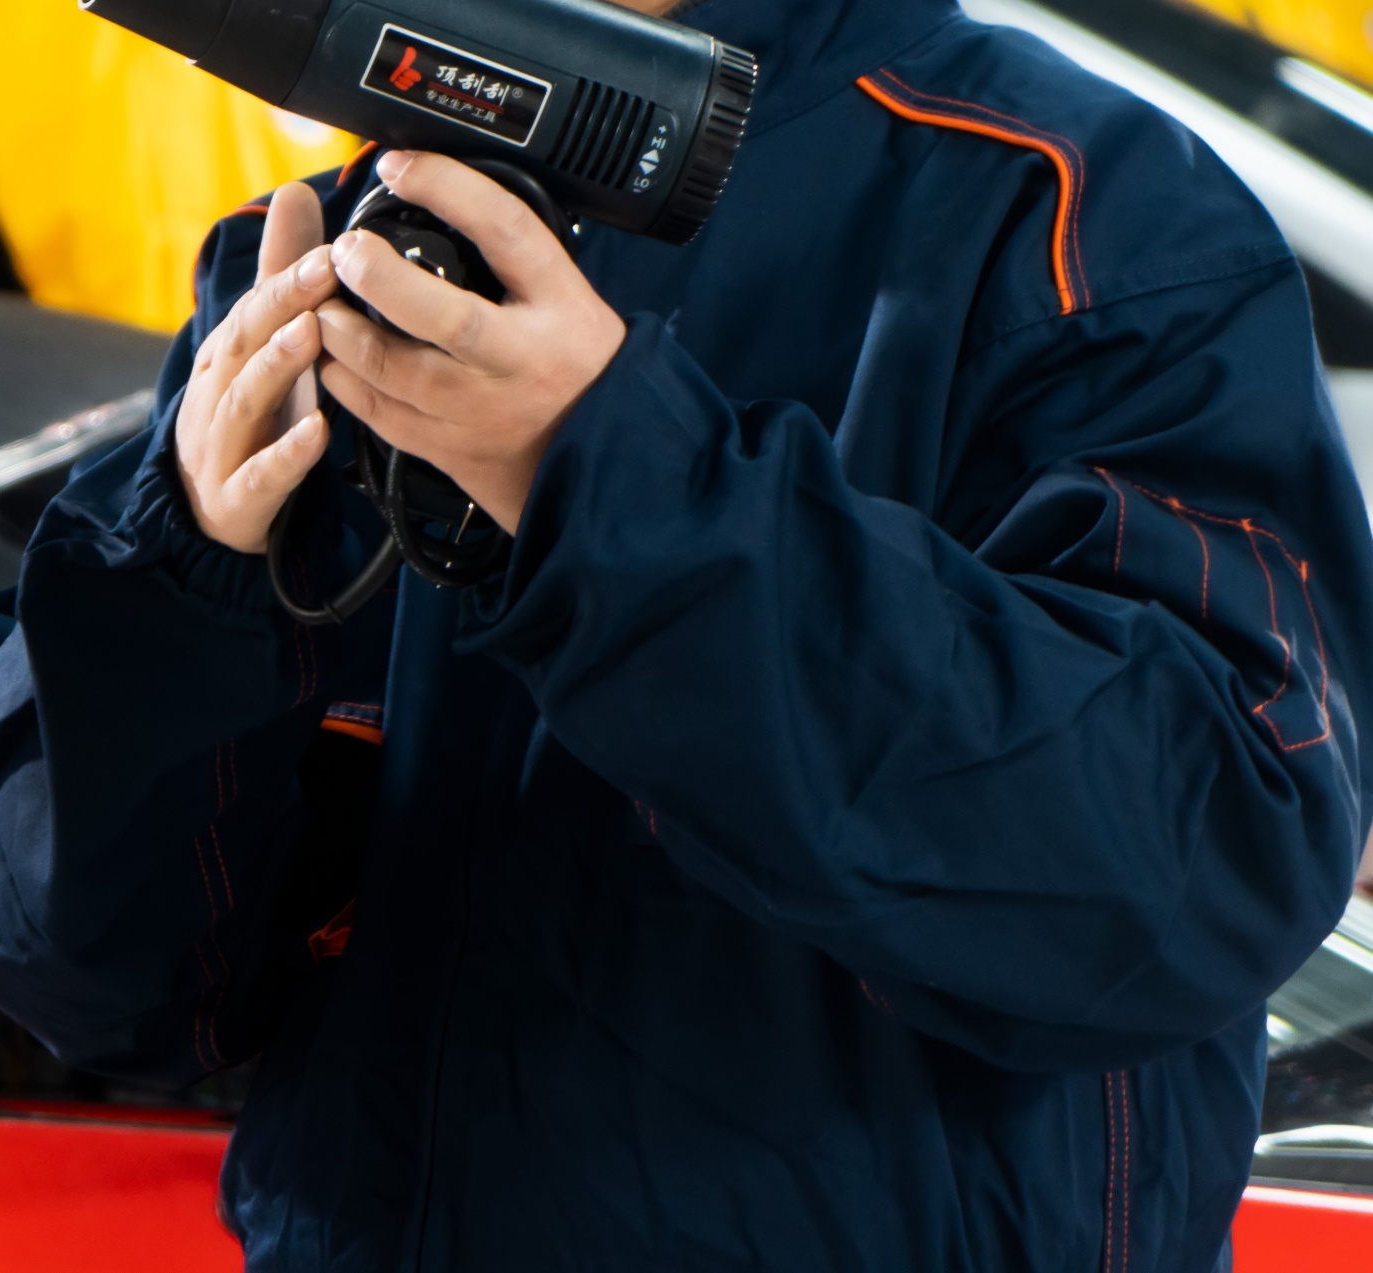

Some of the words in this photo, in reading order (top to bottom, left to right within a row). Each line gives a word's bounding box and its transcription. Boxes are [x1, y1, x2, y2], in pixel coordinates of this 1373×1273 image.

[435, 65, 510, 108] 顶刮刮
[425, 89, 496, 124] 专业生产工具
[650, 135, 667, 150] HI
[633, 176, 650, 188] LO
